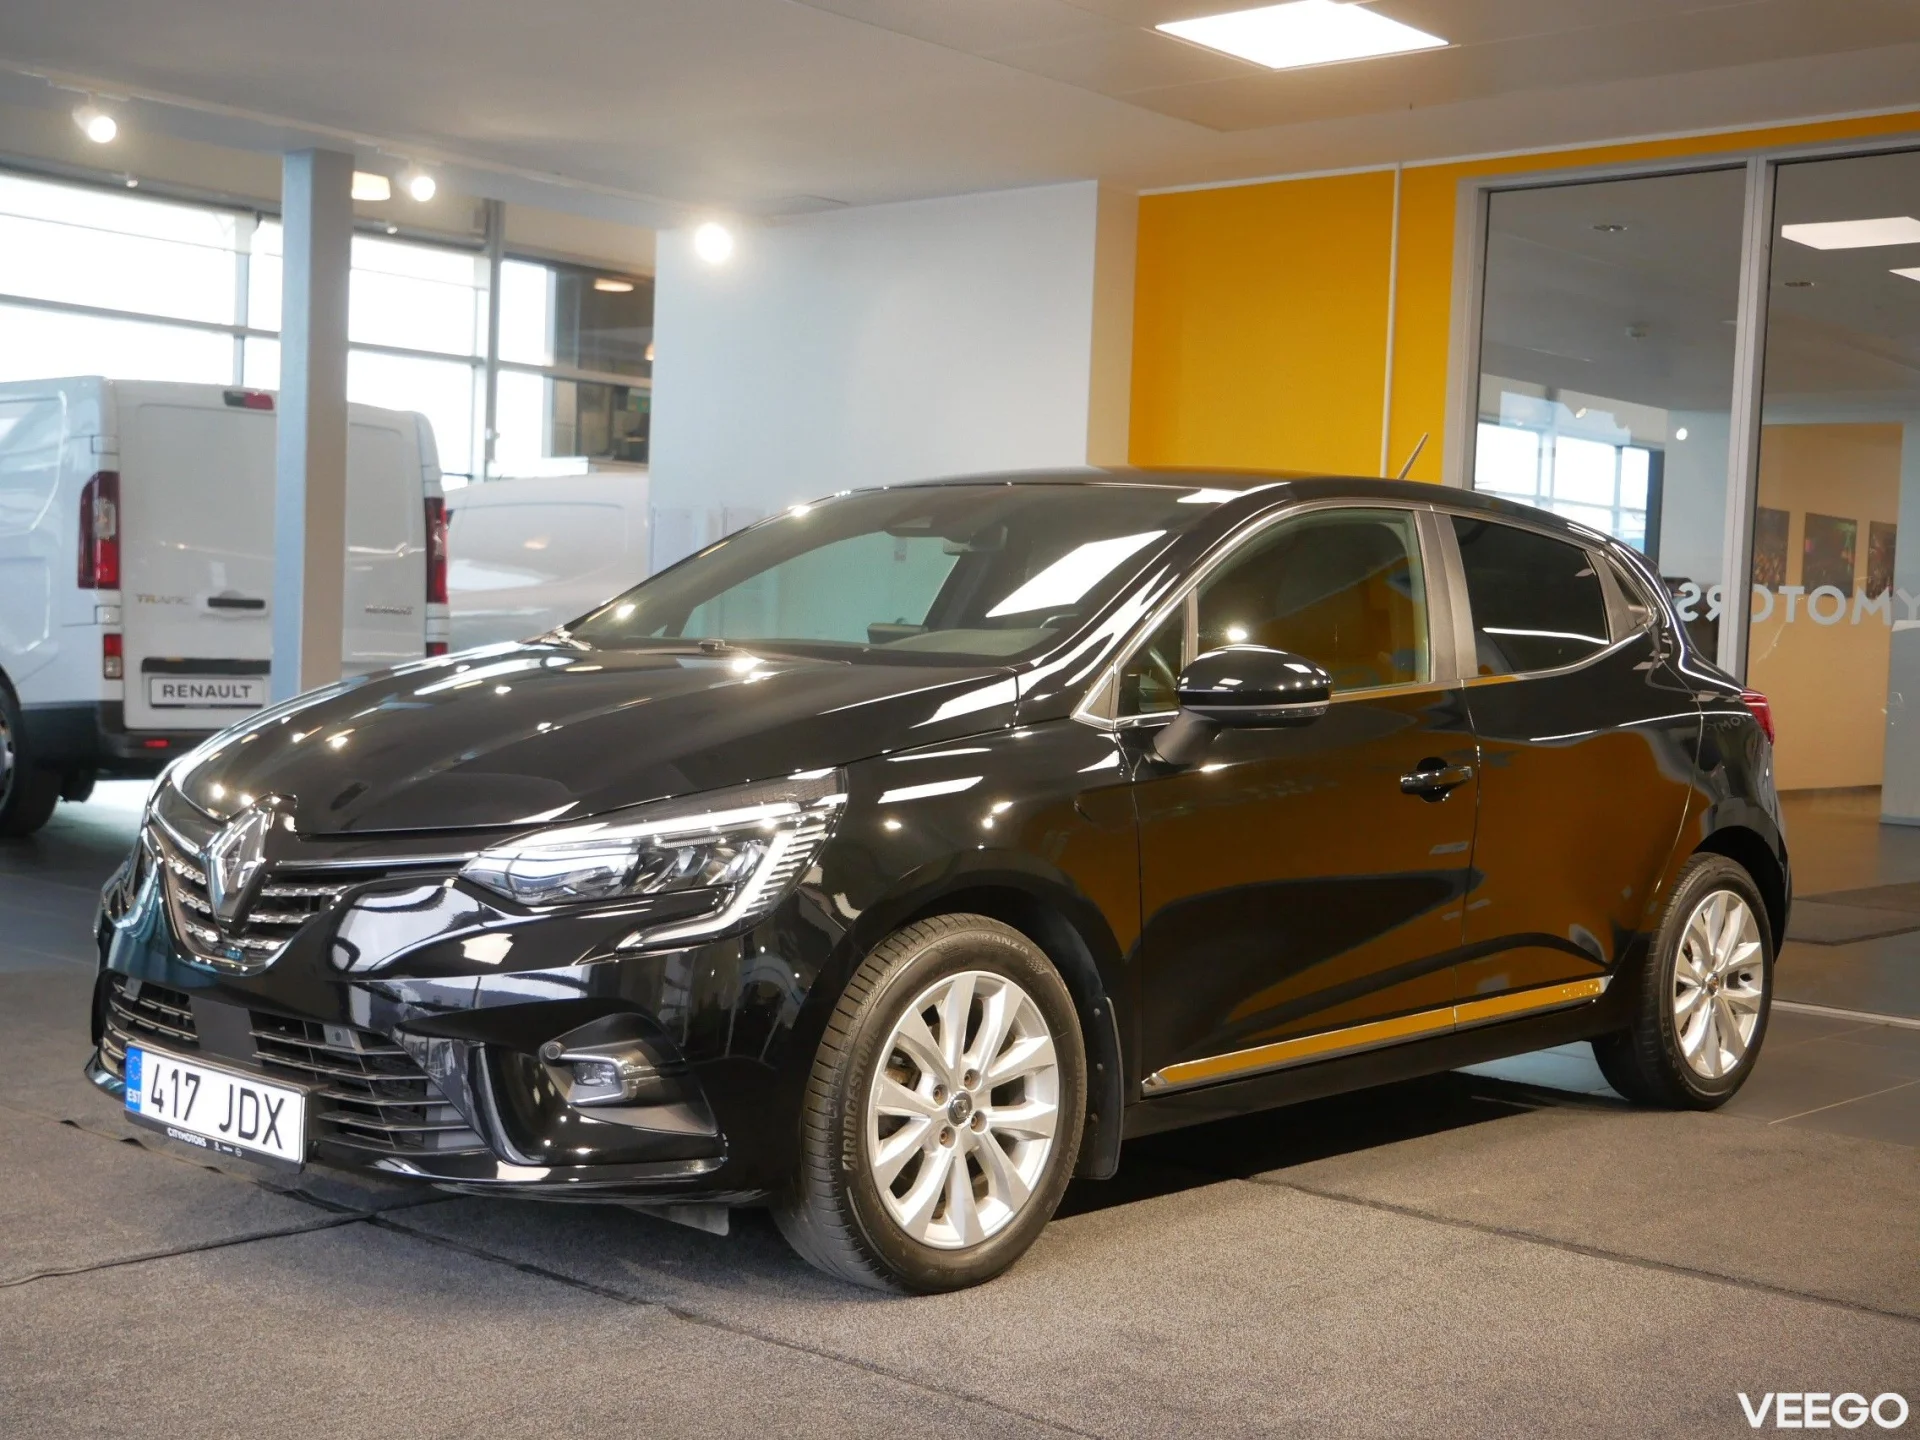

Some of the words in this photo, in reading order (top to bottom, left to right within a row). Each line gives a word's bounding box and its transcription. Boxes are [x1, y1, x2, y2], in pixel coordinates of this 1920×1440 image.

[162, 684, 252, 698] RENAULT
[127, 1088, 142, 1103] EST
[151, 1063, 201, 1121] 417
[218, 1083, 285, 1150] JDX
[166, 1127, 207, 1147] CITYMOTORS
